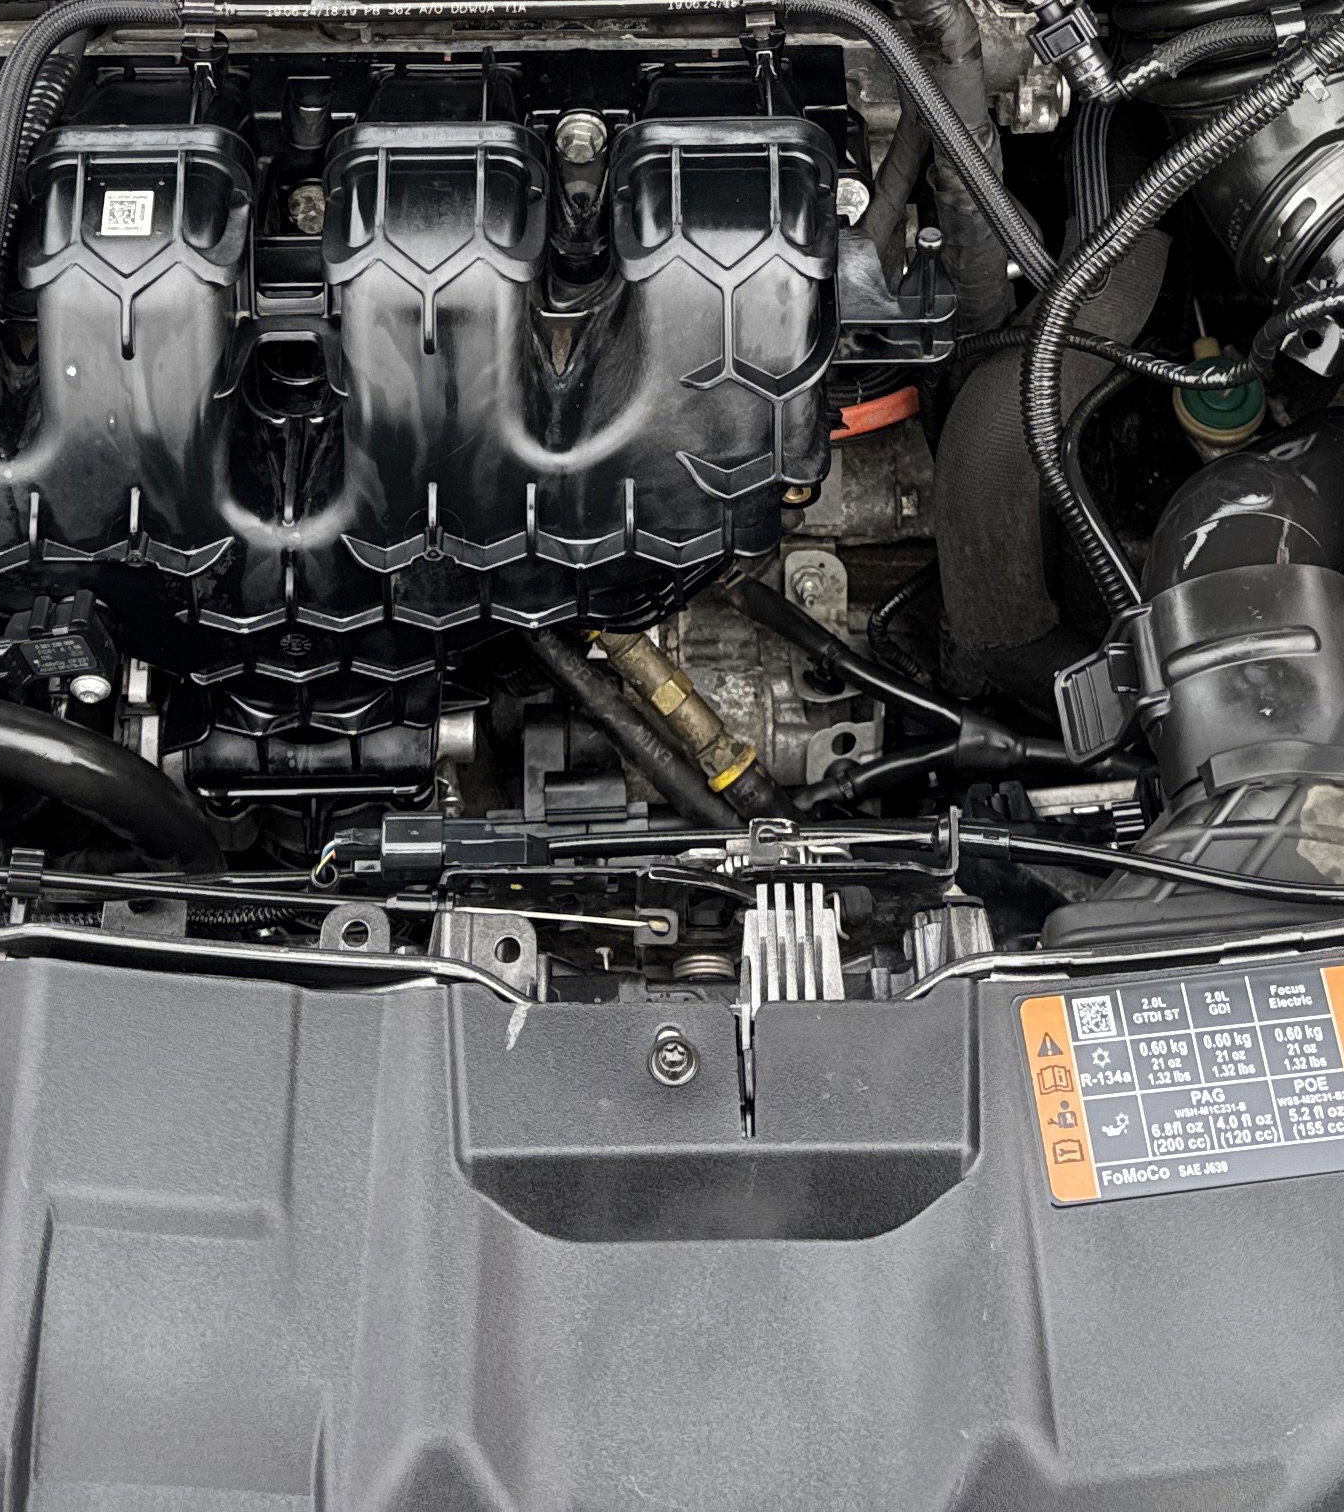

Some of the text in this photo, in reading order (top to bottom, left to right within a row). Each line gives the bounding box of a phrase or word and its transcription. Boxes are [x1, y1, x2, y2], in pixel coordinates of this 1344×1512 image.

[388, 3, 411, 16] 562
[633, 724, 673, 768] EATON
[1204, 990, 1230, 1003] 2.0L
[1269, 984, 1306, 996] Focus
[1141, 996, 1166, 1009] 2.0L
[1208, 1003, 1231, 1016] GDI
[1268, 995, 1313, 1009] Electric
[1132, 1008, 1180, 1024] GTDI ST
[1203, 1031, 1252, 1049] 0.60 kg
[1274, 1024, 1324, 1042] 0.60 kg
[1139, 1038, 1188, 1056] 0.60 kg
[1286, 1043, 1317, 1056] 21 oz
[1151, 1057, 1182, 1070] 21 oz
[1215, 1050, 1246, 1063] 21 oz
[1284, 1055, 1327, 1071] 1.32 lbs
[1080, 1069, 1132, 1087] R-134a
[1148, 1070, 1191, 1085] 1.32 lbs
[1212, 1063, 1256, 1078] 1.32 lbs
[1293, 1076, 1329, 1093] POE
[1190, 1088, 1225, 1105] PAG
[1216, 1113, 1273, 1130] 4.0 fl oz
[1288, 1107, 1311, 1122] 5.2
[1313, 1105, 1325, 1119] fl
[1186, 1121, 1204, 1134] oz
[1292, 1121, 1324, 1140] (155
[1153, 1134, 1211, 1156] (200 cc)
[1220, 1126, 1278, 1149] (120 cc)
[1102, 1160, 1228, 1186] FoMoCo SAE J639
